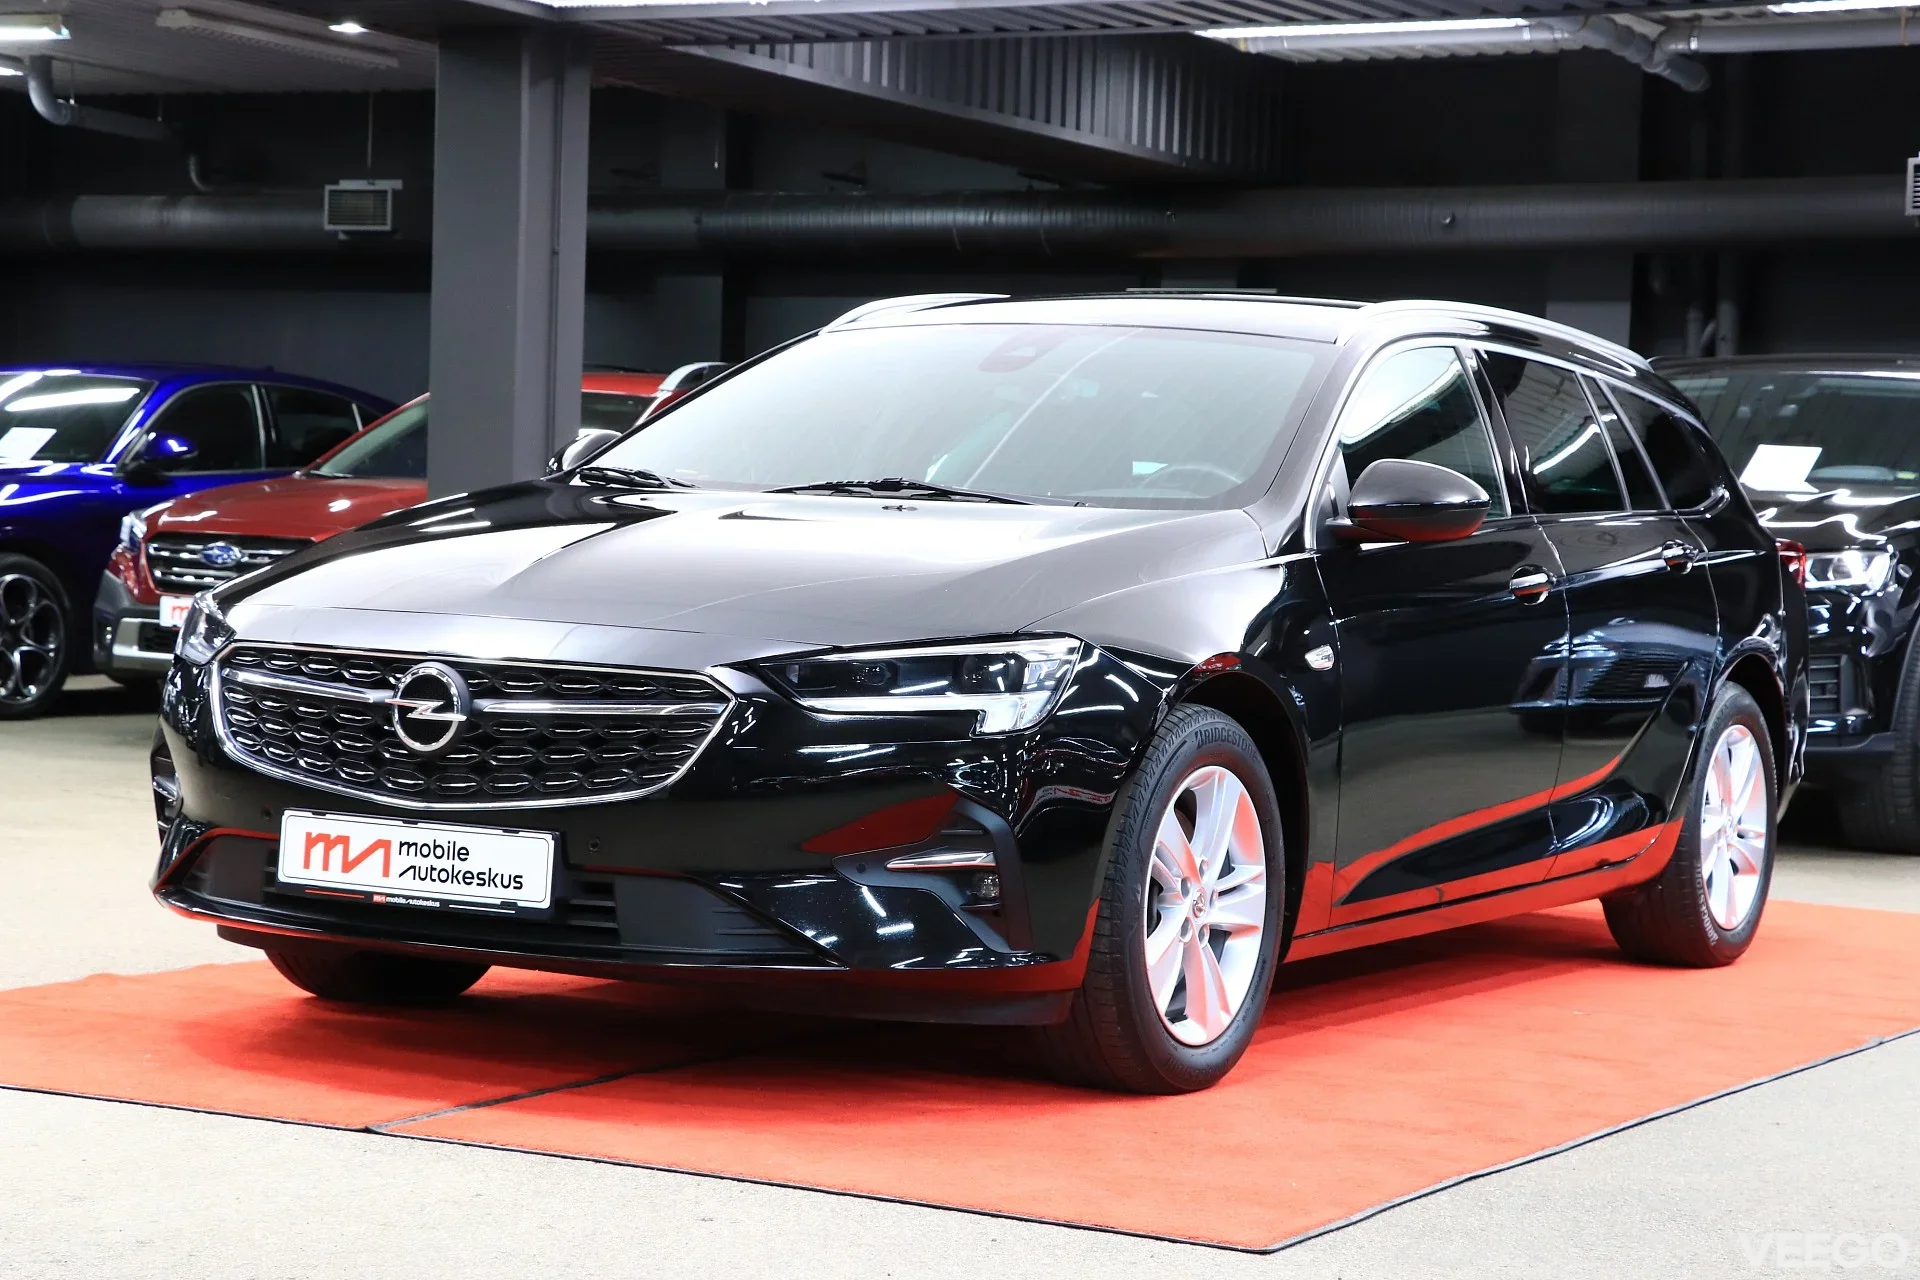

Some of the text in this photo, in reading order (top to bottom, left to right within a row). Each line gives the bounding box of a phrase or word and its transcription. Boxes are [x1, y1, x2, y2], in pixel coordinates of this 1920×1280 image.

[1195, 727, 1259, 763] BRIDGESTONE
[399, 839, 470, 862] mobile
[398, 864, 524, 890] Autokeskus
